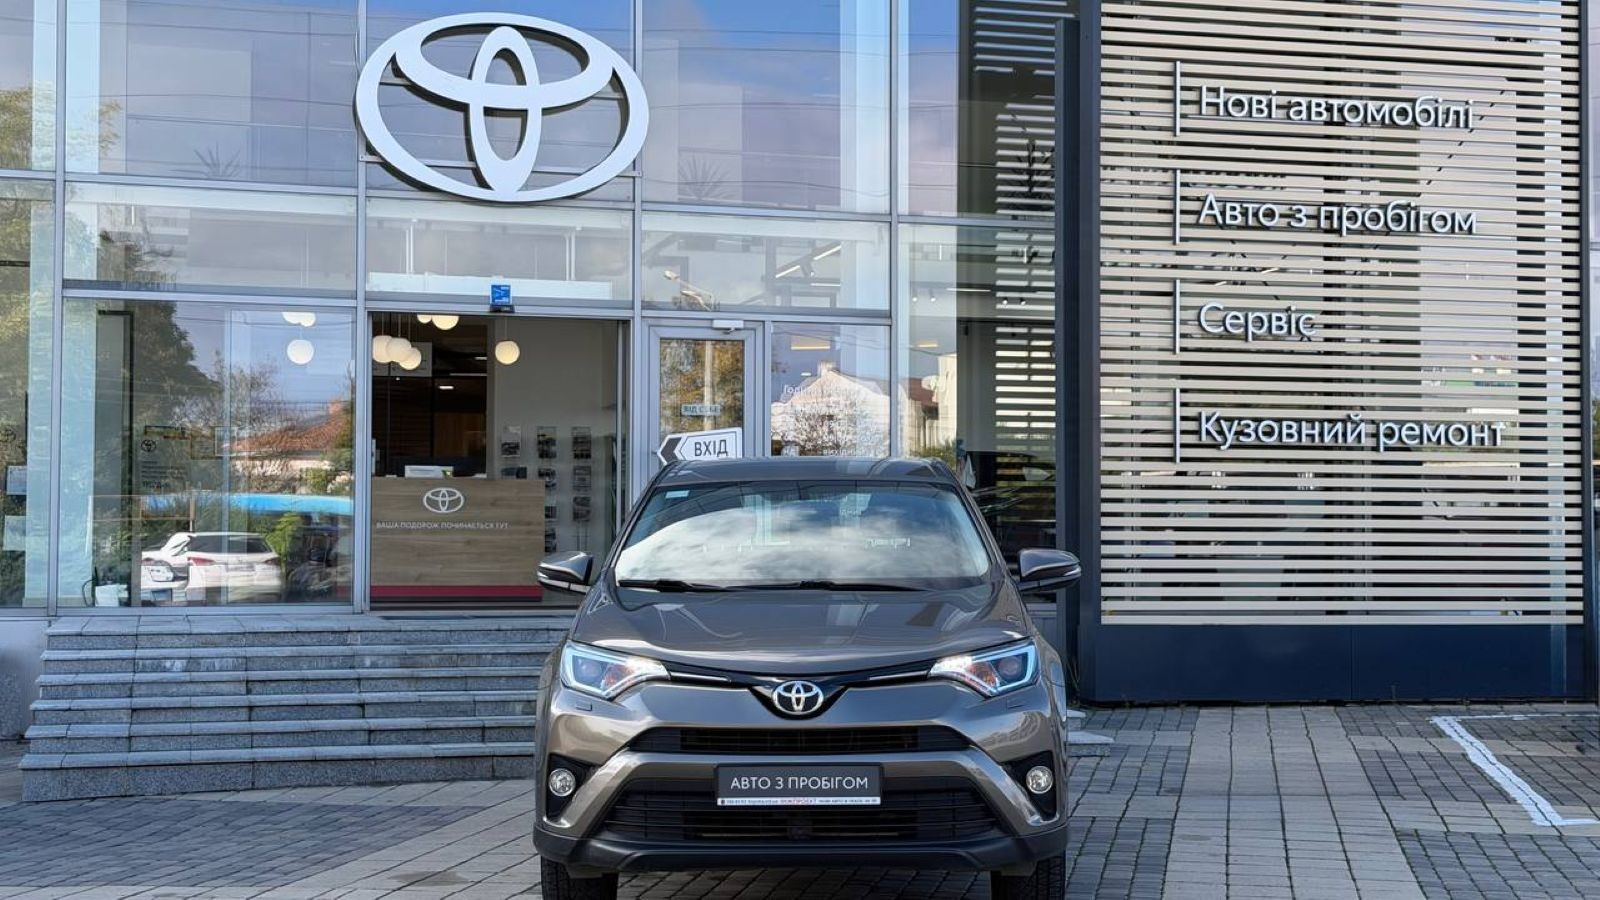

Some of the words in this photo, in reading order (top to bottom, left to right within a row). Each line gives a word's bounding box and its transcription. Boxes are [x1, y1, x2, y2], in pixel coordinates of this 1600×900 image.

[1200, 84, 1278, 118] Нові
[1288, 95, 1474, 129] автомобілі
[1198, 193, 1280, 226] Авто
[1290, 204, 1308, 229] з
[1319, 200, 1477, 237] пробігом
[1199, 302, 1317, 342] Сервіс
[694, 440, 729, 457] ВХІД
[1200, 410, 1368, 451] Кузовний
[1378, 420, 1506, 451] ремонт
[730, 776, 771, 790] АВТО
[788, 776, 868, 790] ПРОБІГОМ
